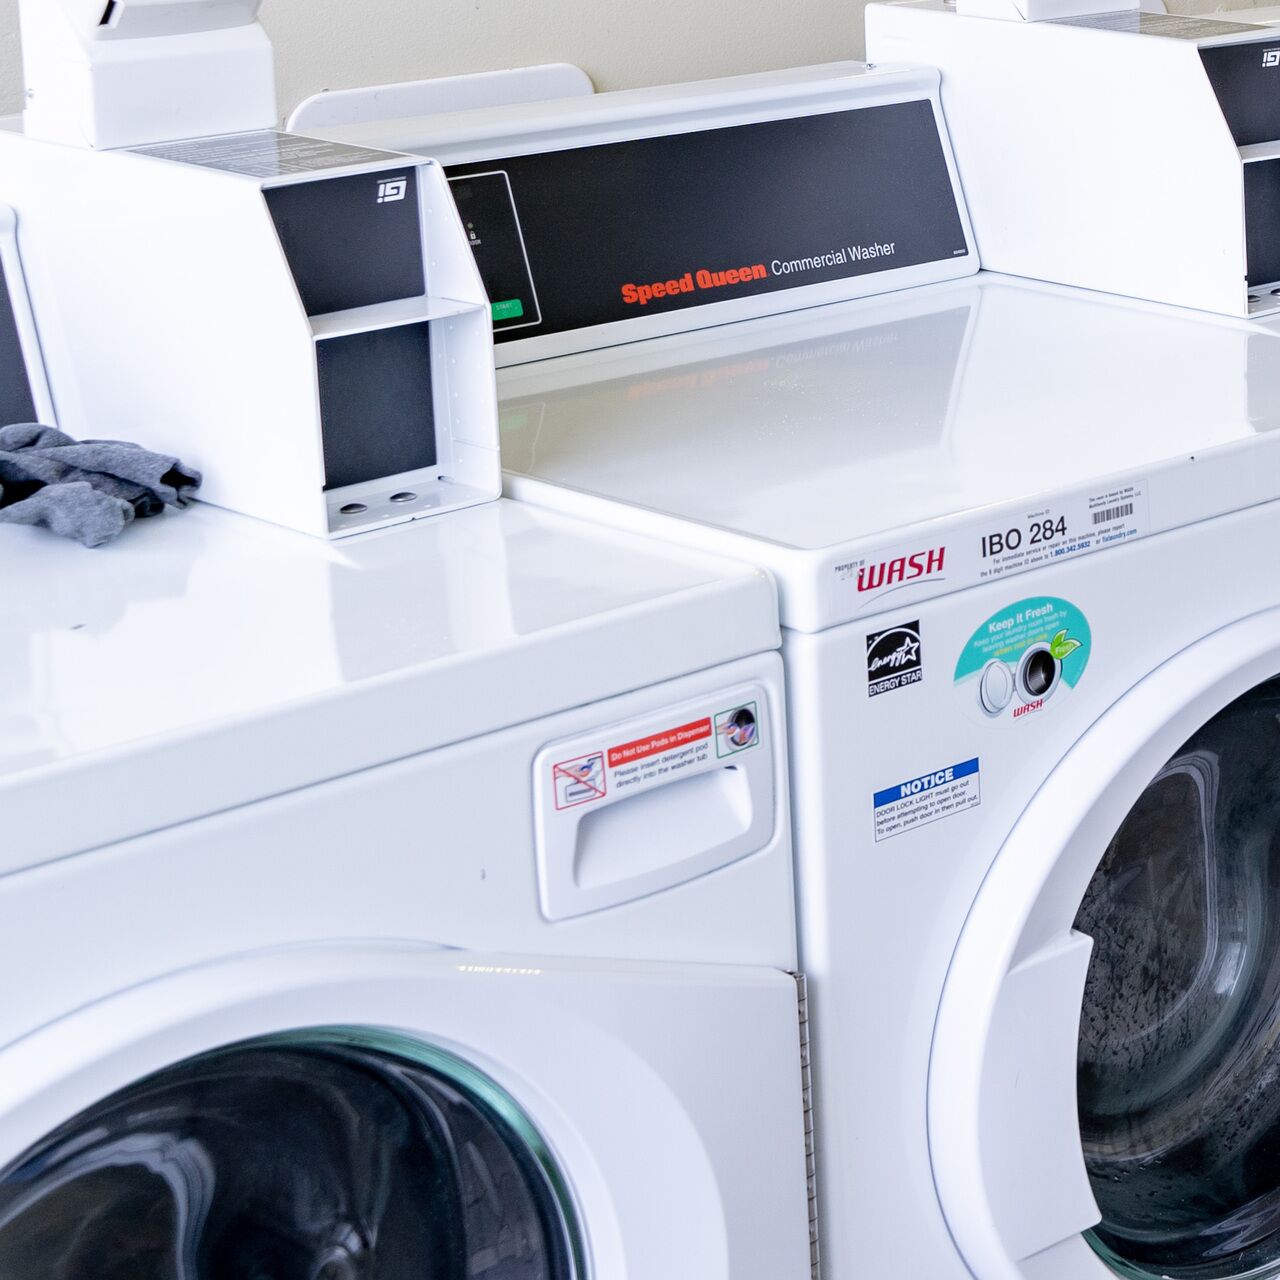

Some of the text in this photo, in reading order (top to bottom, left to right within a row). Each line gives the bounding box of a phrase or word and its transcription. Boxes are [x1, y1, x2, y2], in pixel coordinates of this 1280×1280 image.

[622, 239, 894, 309] Speed Queen Commercial Washer
[495, 302, 513, 311] START
[982, 514, 1067, 558] IBO 284
[835, 561, 858, 573] PROPERTY
[858, 546, 945, 593] WASH
[989, 616, 1014, 635] Keep
[1026, 602, 1053, 621] Fresh
[869, 670, 921, 696] ENERGY STAR
[1014, 698, 1043, 717] WASH
[611, 723, 710, 762] Do Not Use Pods in Dispenser
[615, 742, 708, 778] Please insert detergent pod
[877, 806, 895, 818] DOOR
[896, 799, 913, 811] LOCK
[915, 792, 933, 804] LIGHT
[935, 787, 949, 797] must
[960, 780, 969, 788] out
[901, 768, 953, 798] NOTICE
[877, 815, 895, 827] before
[897, 804, 928, 819] attempting
[937, 796, 951, 806] open
[877, 827, 884, 835] To
[904, 816, 918, 827] push
[920, 810, 933, 820] door
[941, 803, 954, 812] then
[955, 798, 966, 808] pull
